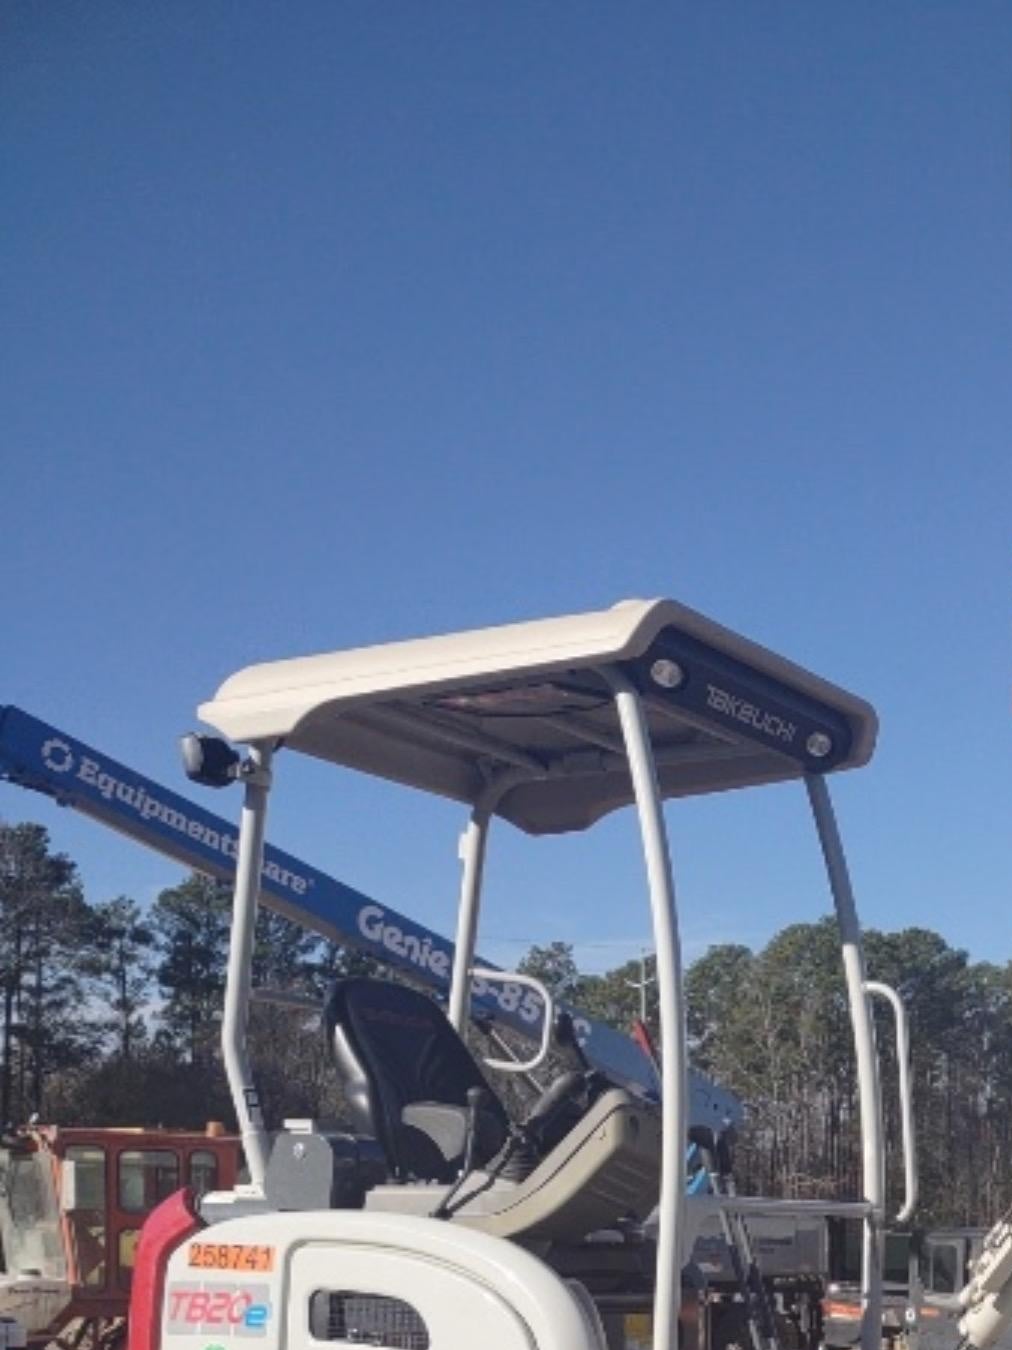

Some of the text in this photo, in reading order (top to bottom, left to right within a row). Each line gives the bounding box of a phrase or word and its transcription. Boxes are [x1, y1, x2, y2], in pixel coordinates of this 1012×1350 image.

[76, 756, 308, 895] Equipmentare
[357, 905, 450, 978] Genie
[188, 1242, 272, 1270] 258741
